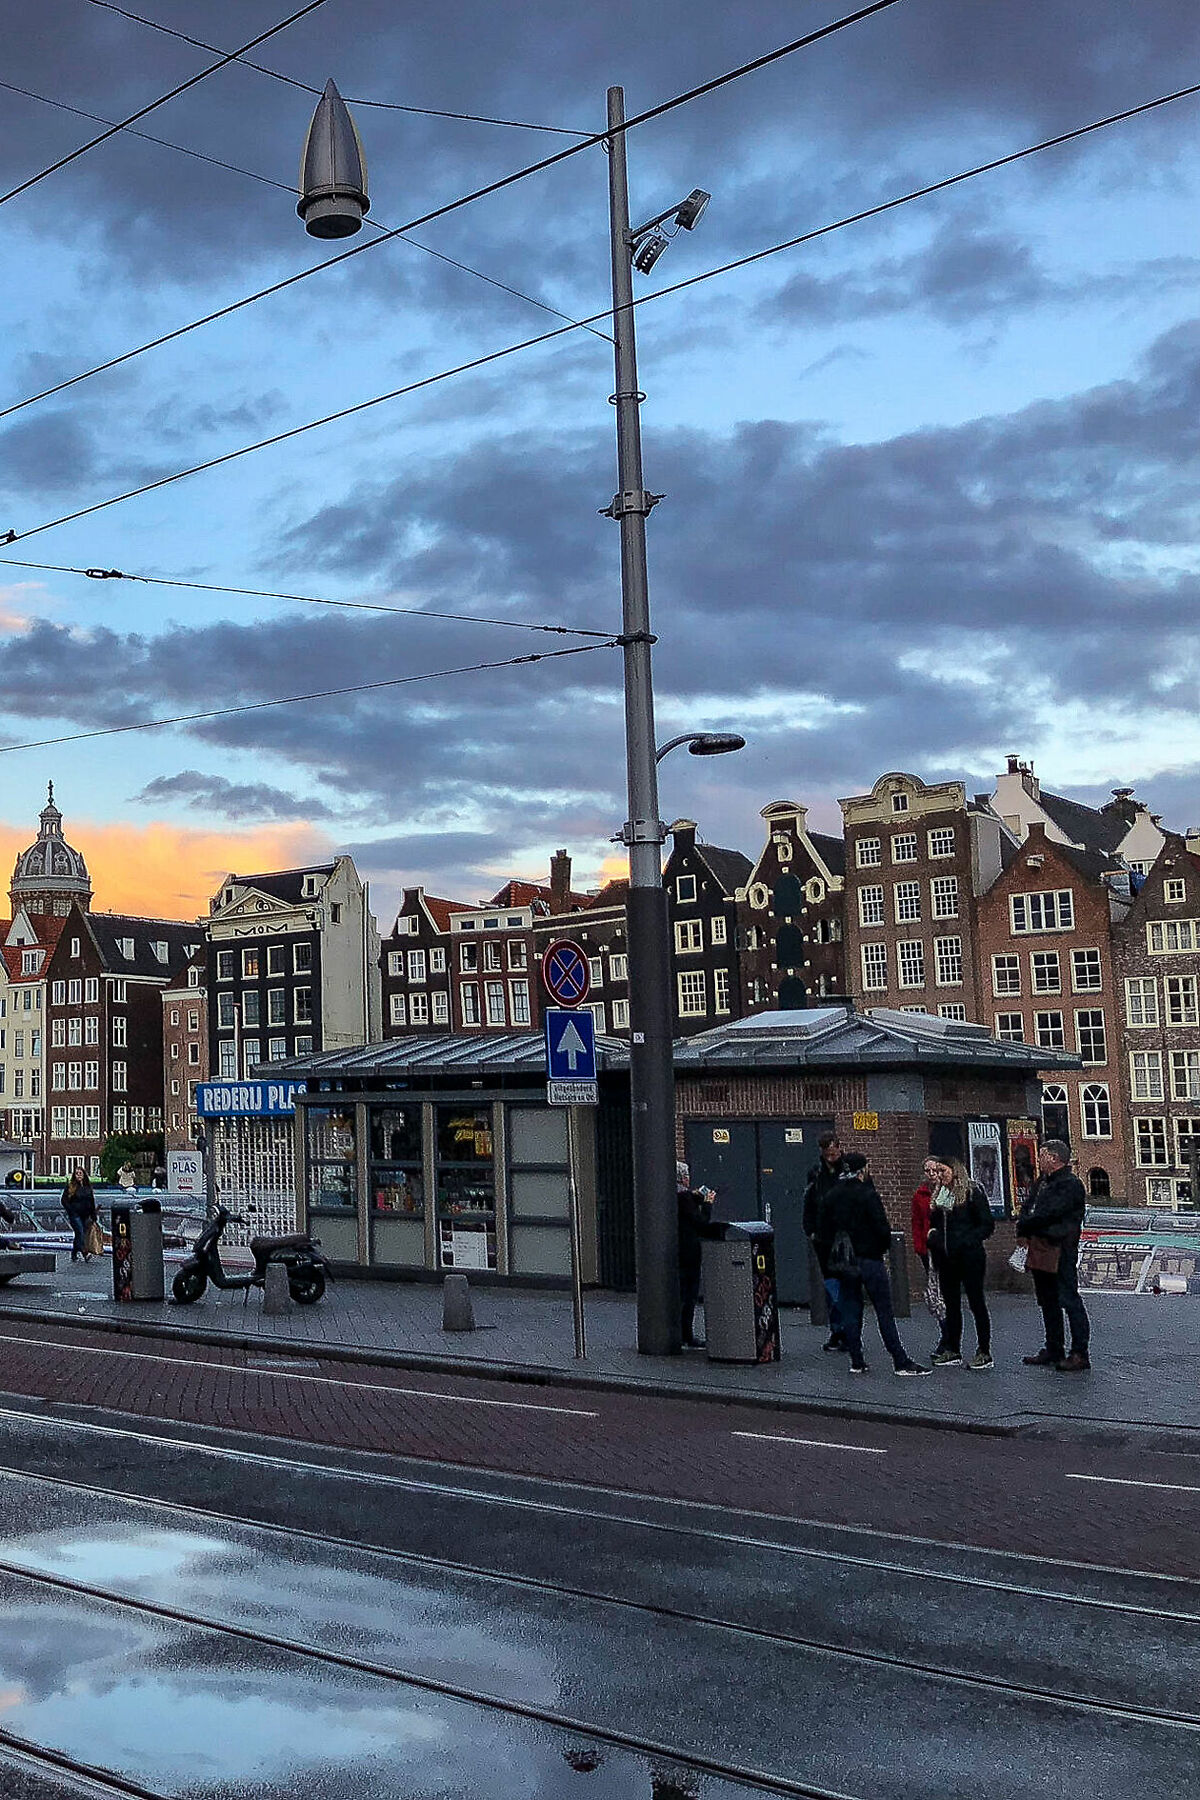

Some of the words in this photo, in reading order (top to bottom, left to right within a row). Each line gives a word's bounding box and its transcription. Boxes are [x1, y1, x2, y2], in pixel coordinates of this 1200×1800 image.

[203, 1086, 262, 1111] REDERIJ
[972, 1123, 999, 1139] WILD
[172, 1161, 197, 1173] PLAS
